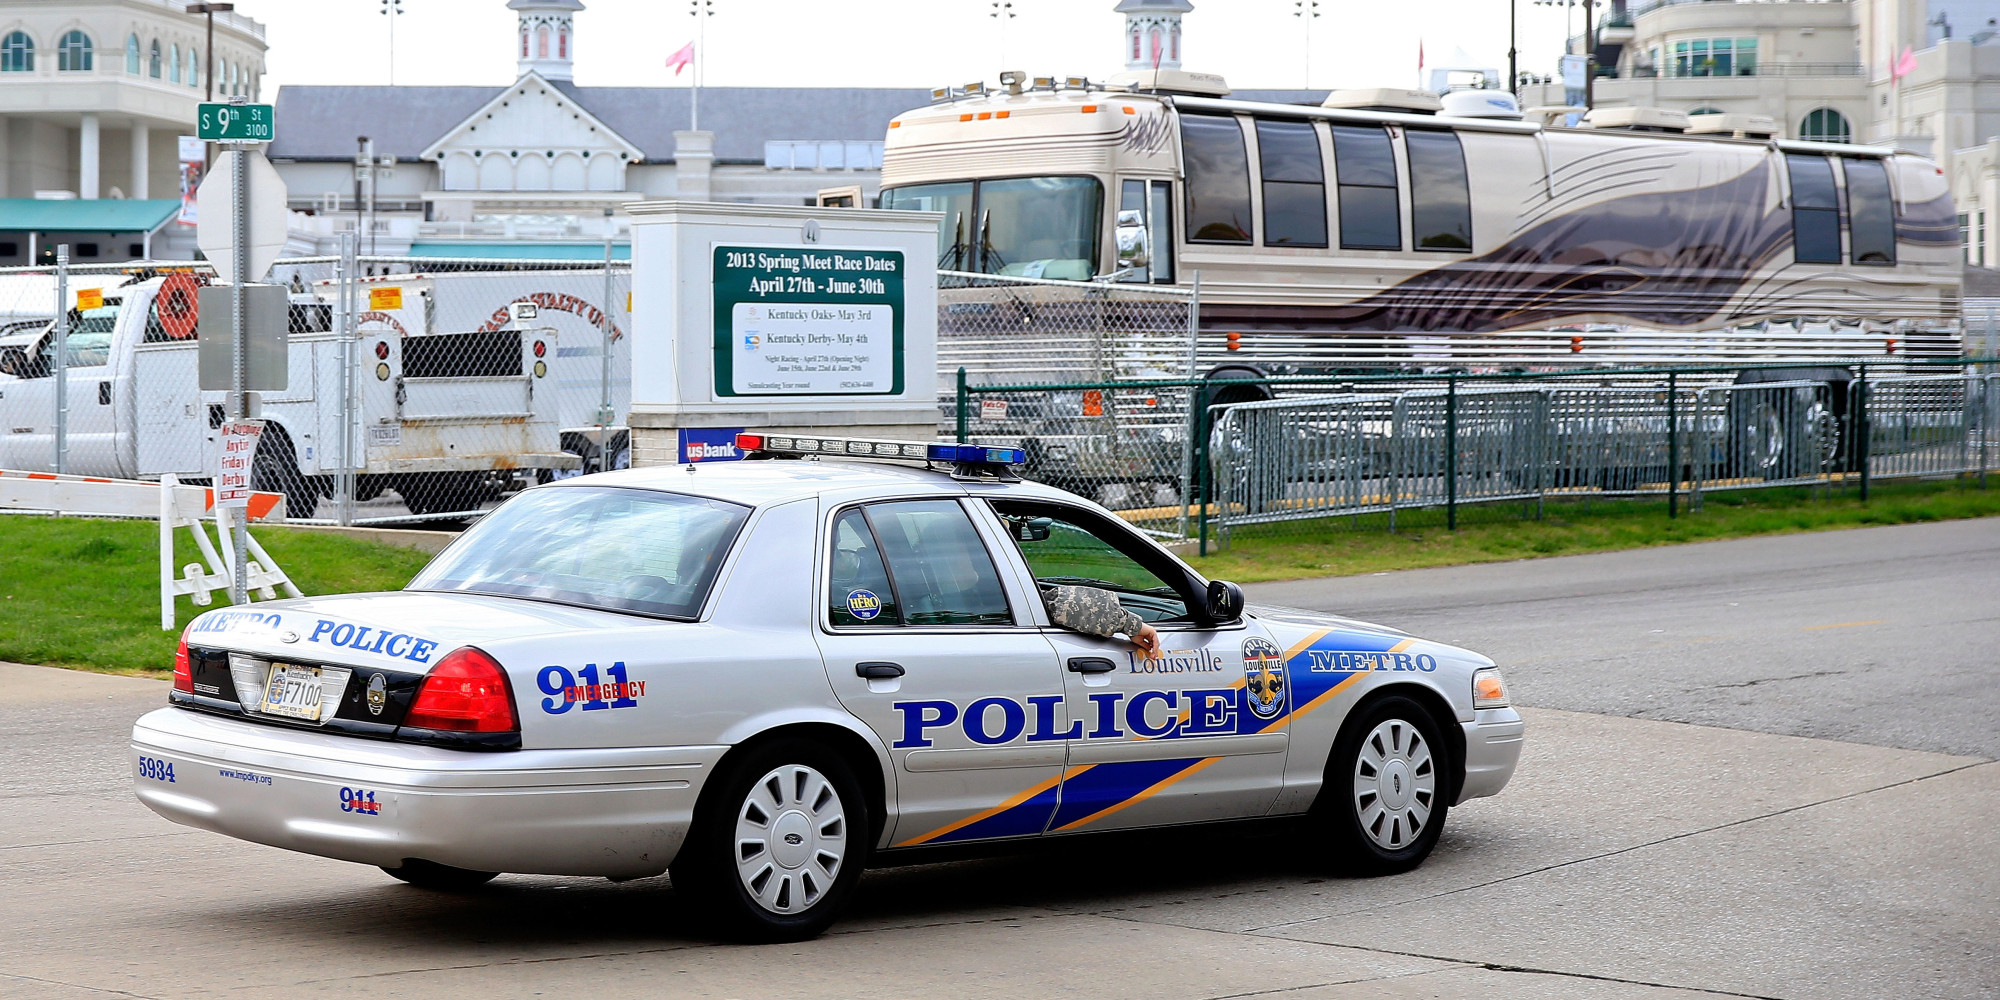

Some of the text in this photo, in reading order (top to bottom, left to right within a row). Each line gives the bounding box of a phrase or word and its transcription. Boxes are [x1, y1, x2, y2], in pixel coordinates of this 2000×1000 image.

[202, 108, 262, 135] S 9th St
[245, 124, 268, 136] 3100
[726, 252, 896, 273] 2013 Spring Meet Race Dates
[748, 276, 784, 297] April
[786, 276, 815, 293] 27th
[826, 277, 856, 294] June
[858, 278, 885, 294] 30th
[768, 308, 872, 323] Kentucky Oaks- May 3rd
[767, 333, 804, 346] Kentucky
[807, 333, 836, 346] Derby-
[838, 333, 854, 346] May
[855, 334, 869, 344] 4th
[780, 355, 799, 364] Racing
[803, 355, 818, 364] April
[747, 381, 781, 389] Simulcasting
[221, 456, 245, 470] Friday
[222, 473, 245, 486] Derby
[849, 596, 879, 609] HERO
[308, 619, 439, 664] POLICE
[1245, 640, 1276, 657] POLICE
[1127, 648, 1222, 675] Louisville
[1244, 660, 1282, 671] LOUISVILLE
[1309, 651, 1437, 673] METRO
[283, 681, 322, 706] F7100
[536, 661, 638, 715] 911
[564, 681, 646, 703] EMERGENCY
[892, 687, 1238, 749] POLICE
[139, 755, 176, 783] 5934
[219, 769, 272, 786] www.lmpdky.org
[340, 786, 379, 815] 911
